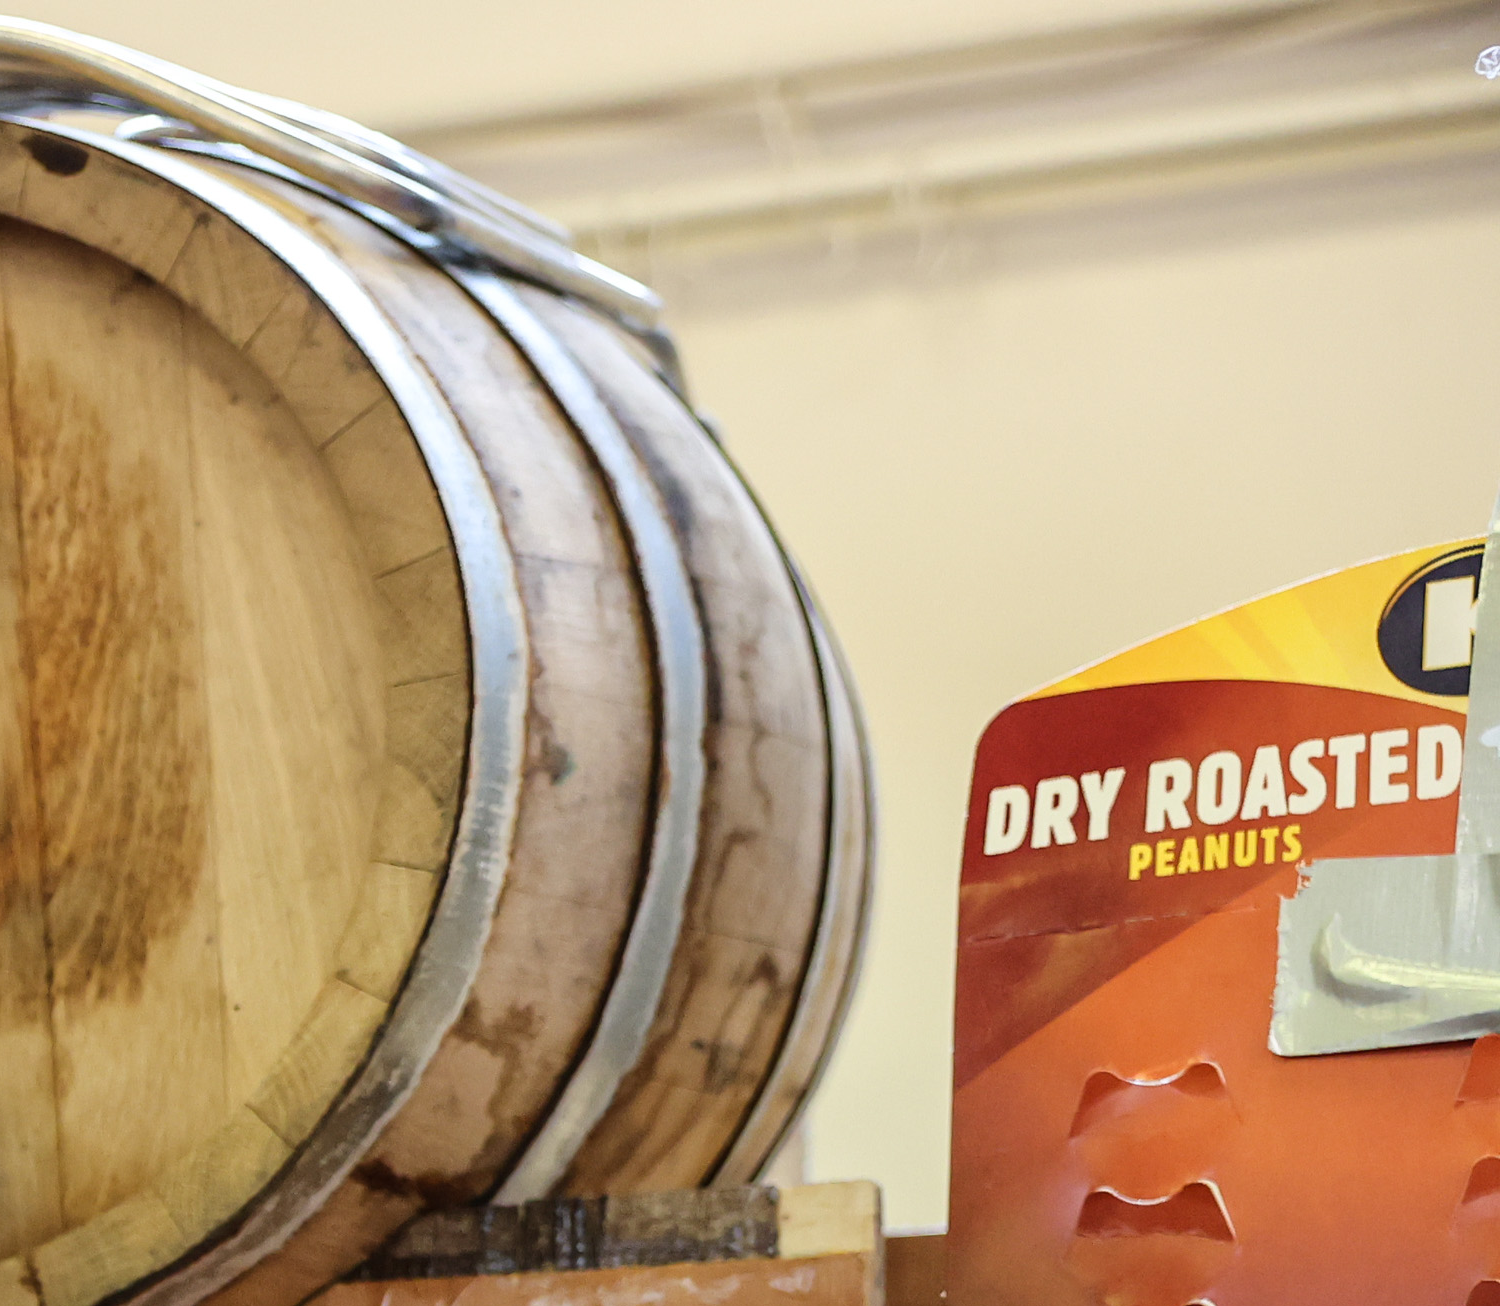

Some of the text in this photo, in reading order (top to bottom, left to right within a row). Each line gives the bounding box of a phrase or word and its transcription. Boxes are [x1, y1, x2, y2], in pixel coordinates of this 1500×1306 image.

[983, 723, 1463, 857] DRY ROASTED
[1127, 825, 1303, 881] PEANUTS
